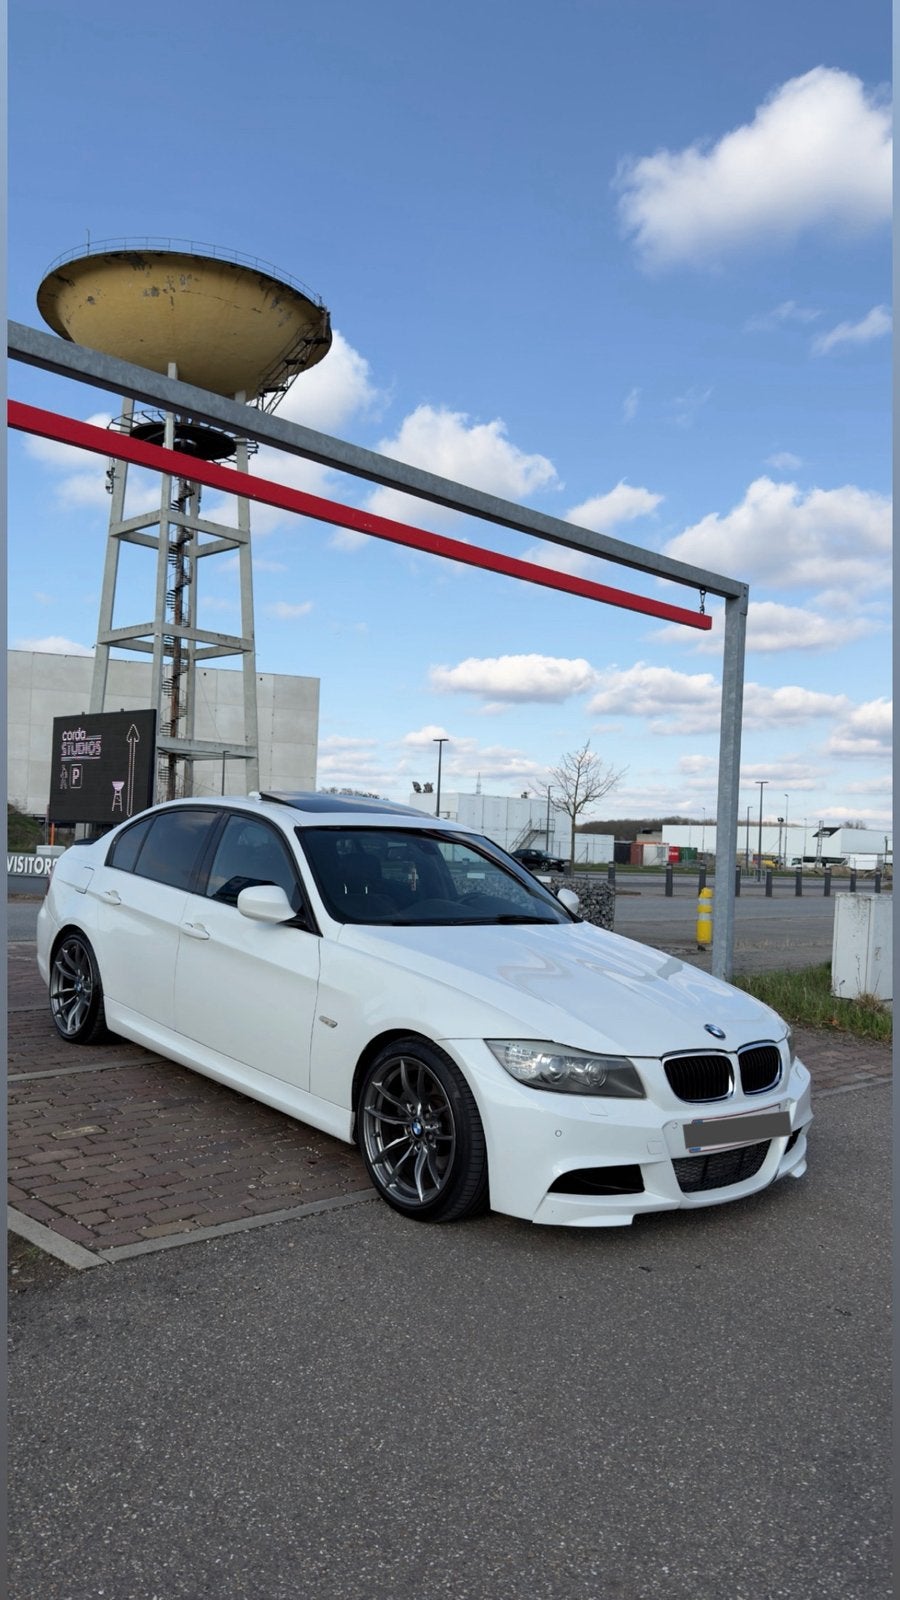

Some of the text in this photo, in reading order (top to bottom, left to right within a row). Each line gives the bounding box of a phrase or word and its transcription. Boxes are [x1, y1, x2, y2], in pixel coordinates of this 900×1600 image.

[62, 728, 87, 741] corda
[61, 741, 102, 756] STUDIOS
[72, 767, 80, 785] P
